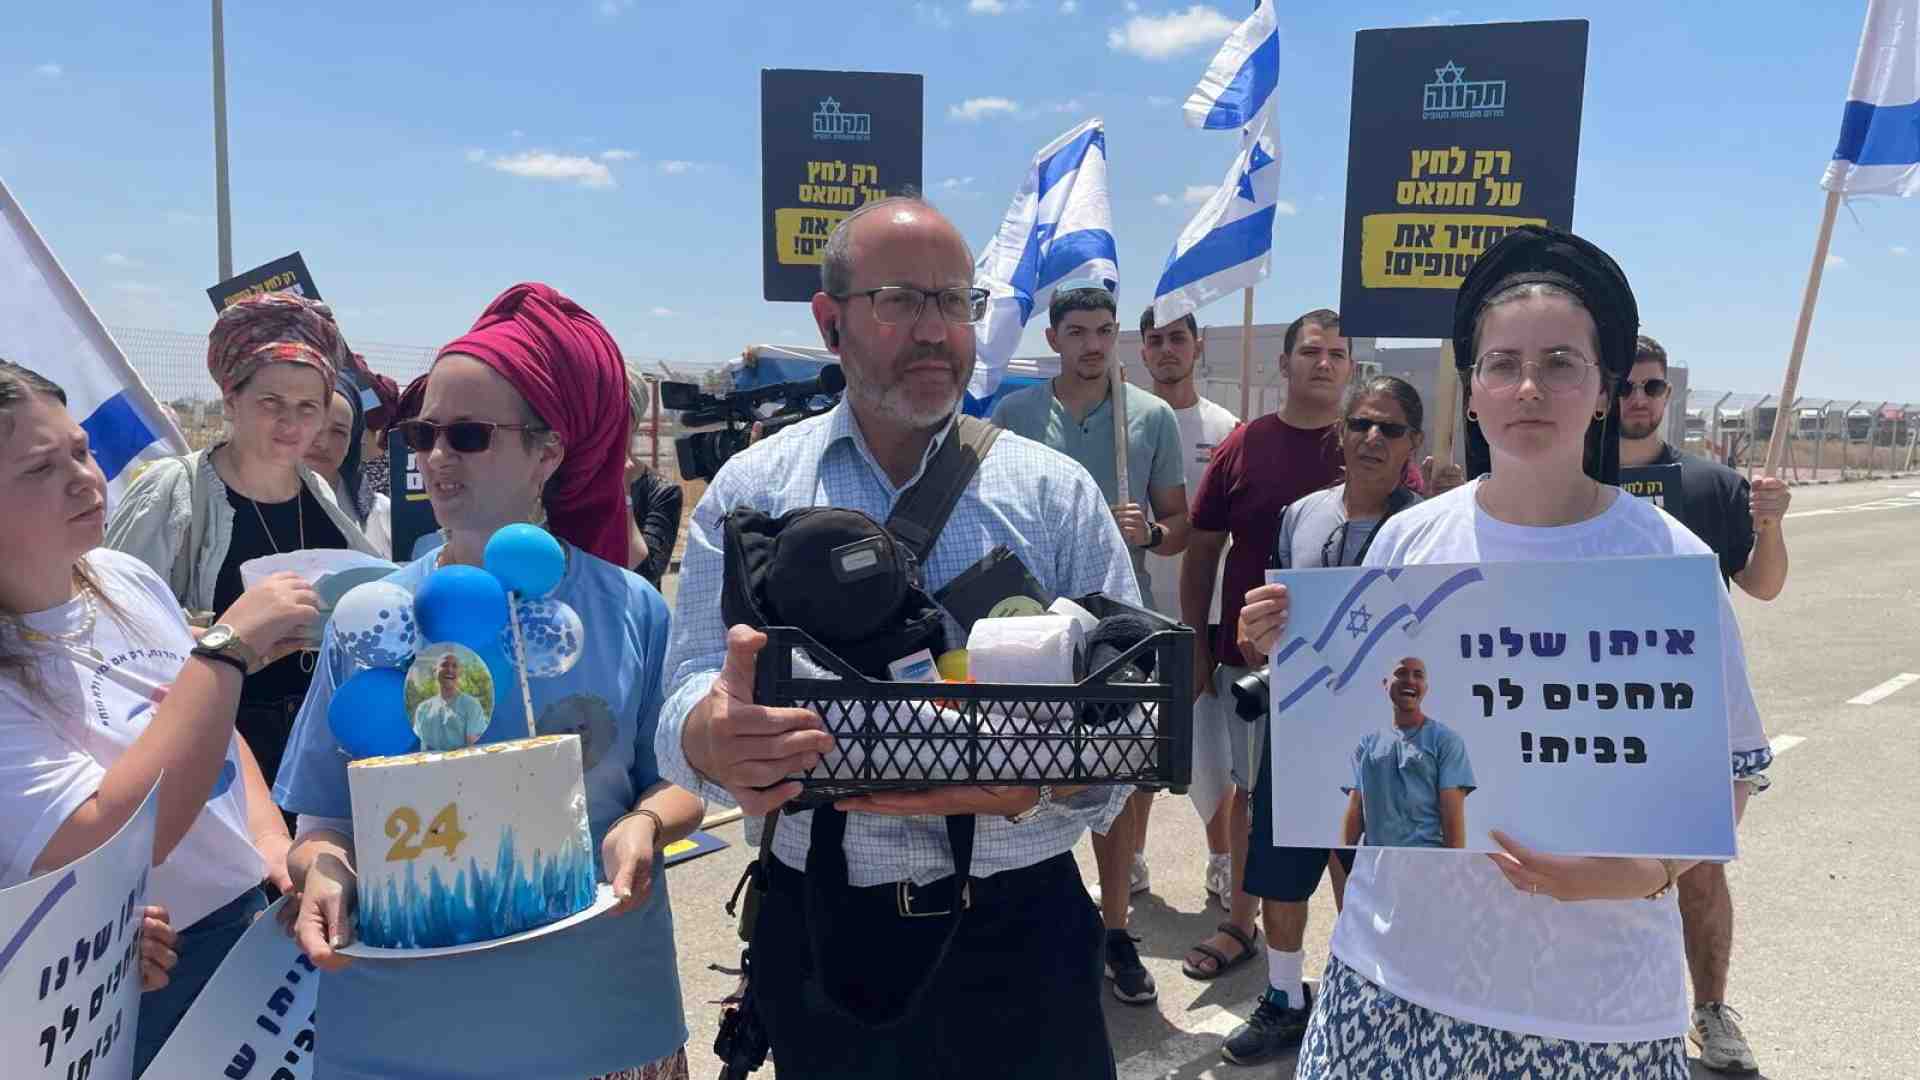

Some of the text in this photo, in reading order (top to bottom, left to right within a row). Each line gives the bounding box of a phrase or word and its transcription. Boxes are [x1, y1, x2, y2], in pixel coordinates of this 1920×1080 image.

[807, 160, 878, 185] רק לחץ
[1411, 146, 1512, 179] רק לחץ
[799, 184, 855, 205] חמאס
[1396, 176, 1522, 207] על חמאס
[799, 216, 828, 235] את
[1393, 223, 1436, 249] את
[1384, 250, 1480, 277] טופים!
[1460, 627, 1695, 662] איתן שלנו
[1472, 678, 1694, 717] מחכים לך
[1520, 731, 1648, 763] בבית!
[385, 803, 466, 862] 24
[39, 920, 114, 1001] שלנו
[39, 1004, 79, 1069] לך
